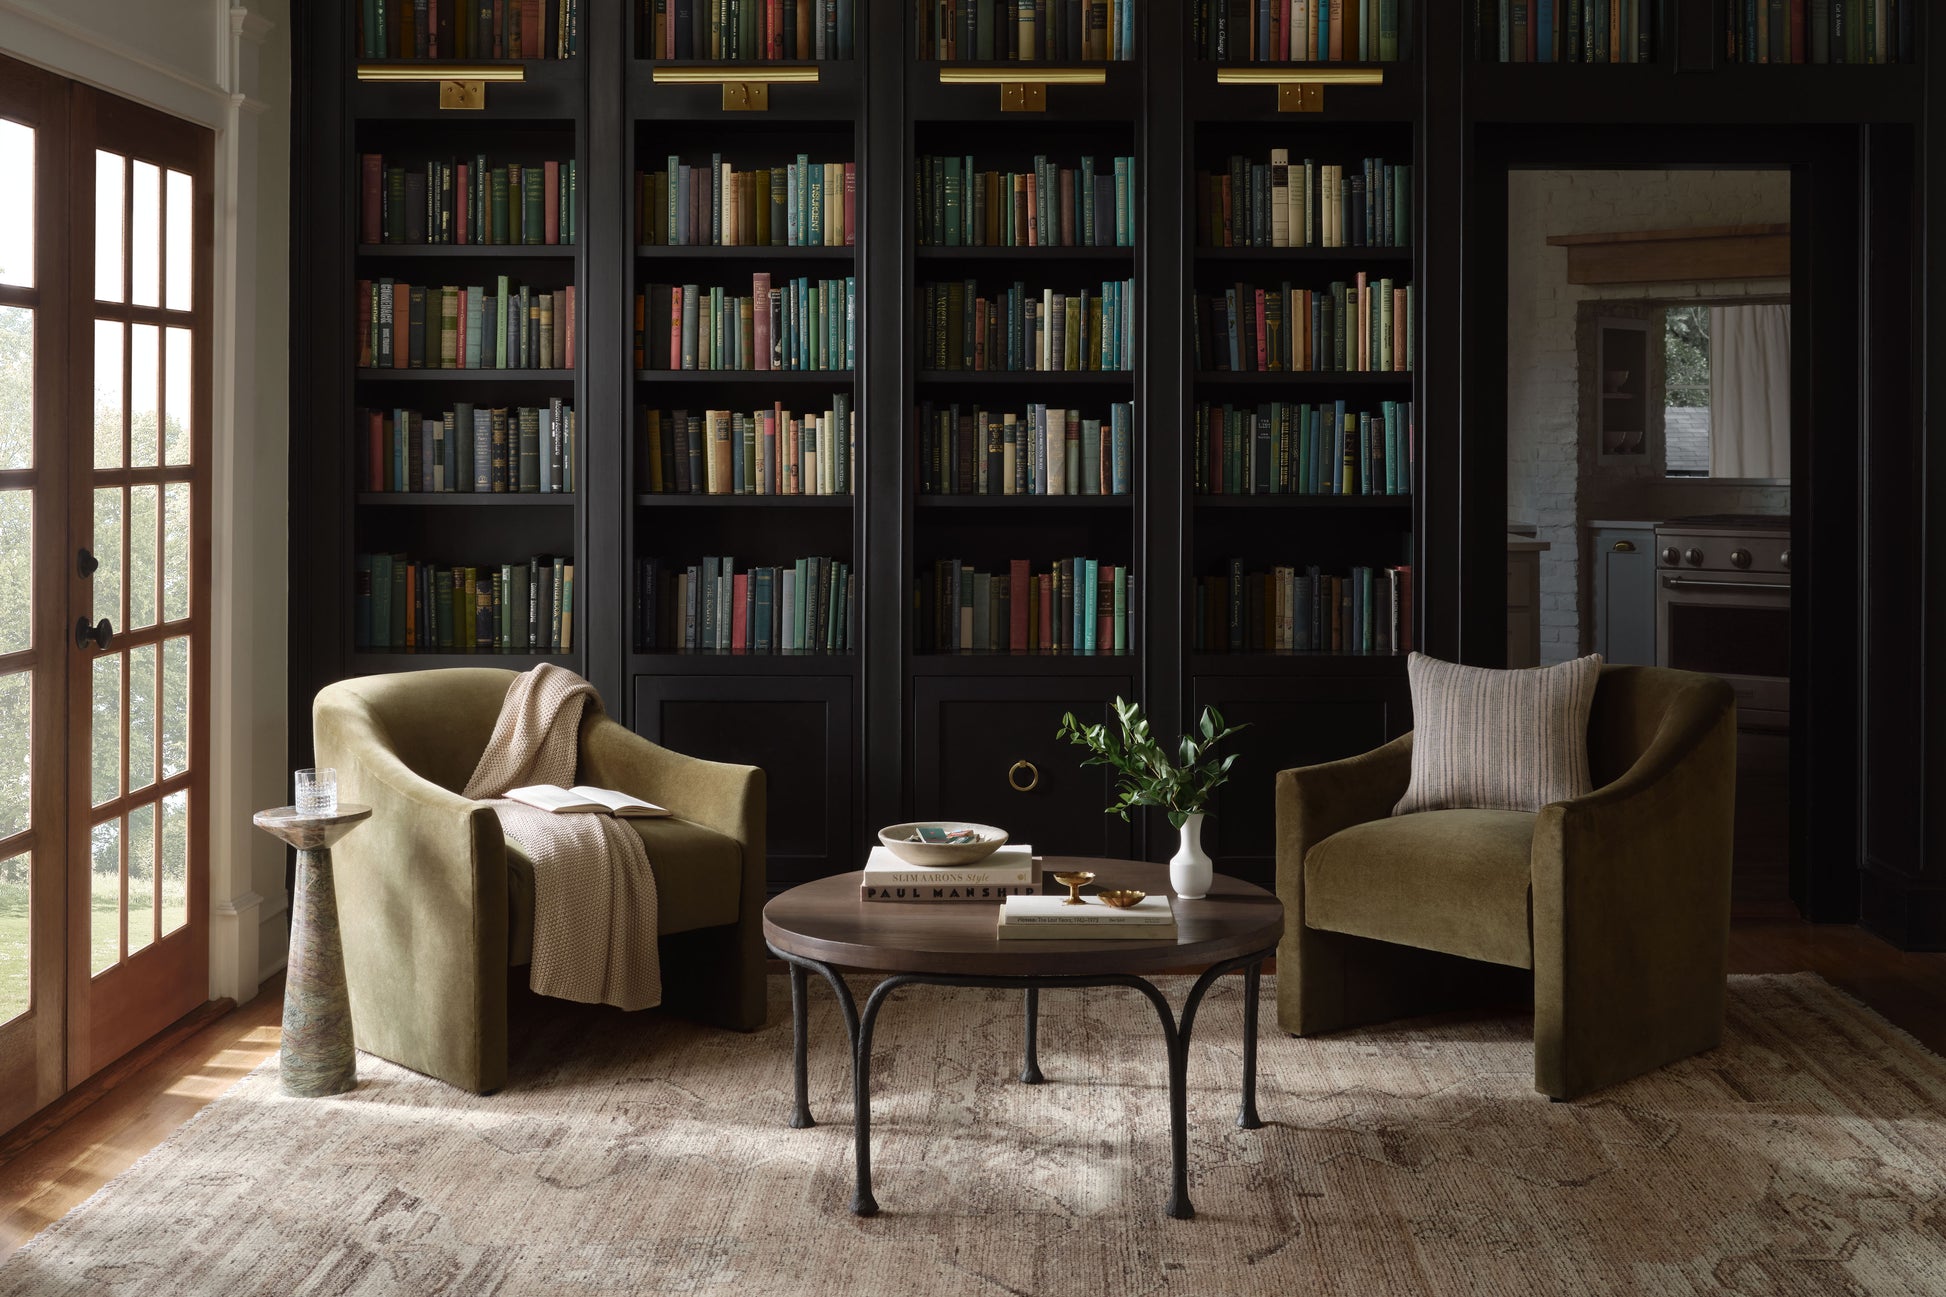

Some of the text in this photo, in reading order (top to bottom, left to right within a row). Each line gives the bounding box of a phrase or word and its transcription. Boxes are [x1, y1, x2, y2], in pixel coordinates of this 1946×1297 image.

[892, 873, 990, 883] SLIM AARONS Style
[867, 887, 1035, 898] PAUL MANSHIP
